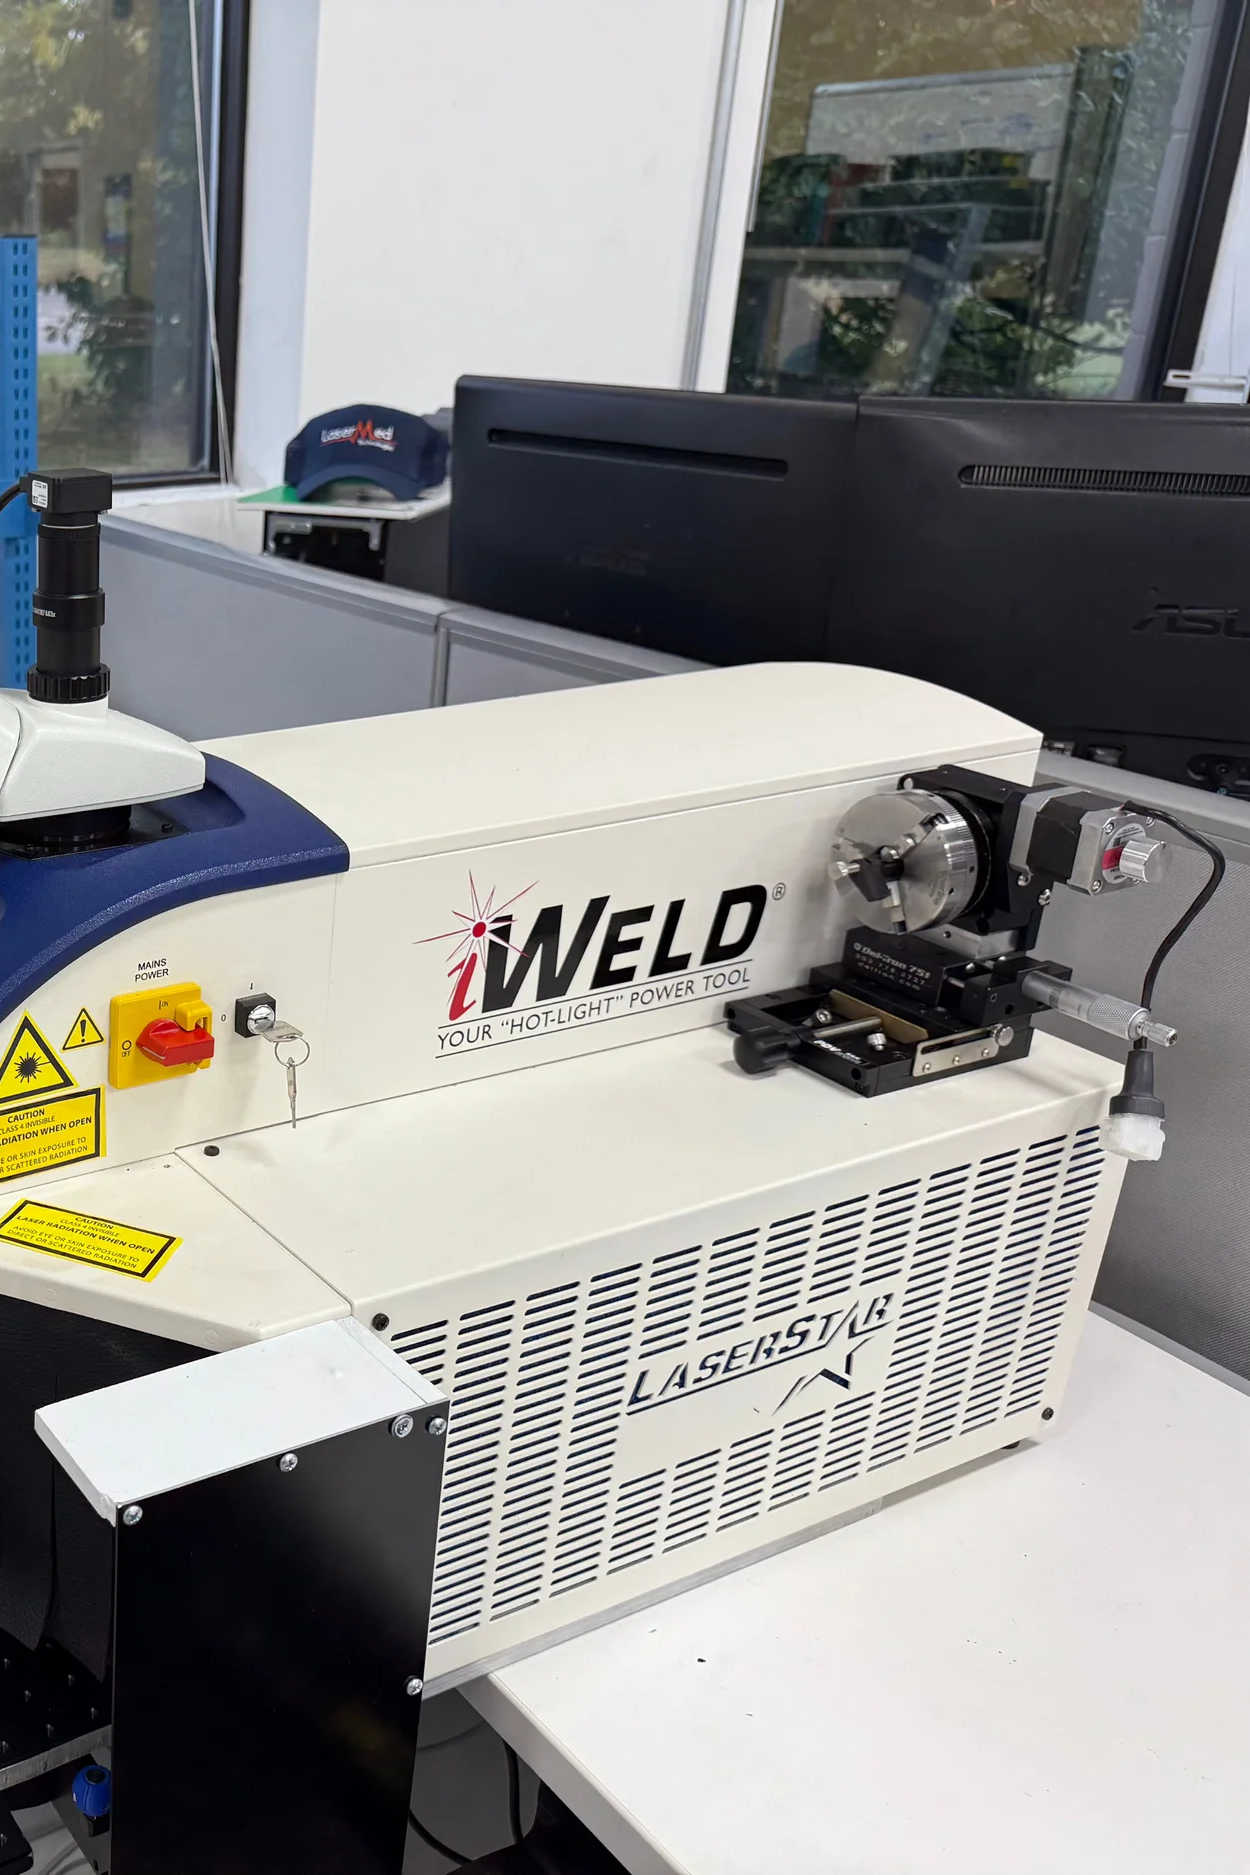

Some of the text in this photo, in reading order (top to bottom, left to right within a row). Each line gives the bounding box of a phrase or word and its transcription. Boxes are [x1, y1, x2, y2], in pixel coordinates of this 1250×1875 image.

[321, 419, 394, 443] LaserMed
[135, 969, 169, 982] POWER
[138, 958, 166, 971] MAINS
[437, 1024, 493, 1050] YOUR
[629, 979, 695, 1008] POWER
[702, 967, 751, 992] TOOL
[8, 1109, 45, 1123] CAUTION
[25, 1116, 55, 1128] INVISIBLE
[40, 1123, 66, 1136] WHEN
[69, 1116, 92, 1128] OPEN
[6, 1157, 47, 1172] SCATTERED
[50, 1145, 88, 1160] RADIATION
[7, 1154, 18, 1162] OR
[20, 1150, 36, 1159] SKIN
[38, 1139, 75, 1154] EXPOSURE
[16, 1215, 156, 1254] LASER RADIATION WHEN OPEN
[60, 1219, 81, 1227] CLASS
[87, 1225, 121, 1237] INVISIBLE
[75, 1217, 115, 1229] CAUTION
[7, 1229, 34, 1240] DIRECT
[48, 1240, 93, 1256] SCATTERED
[93, 1253, 137, 1268] RADIATION
[13, 1226, 38, 1235] AVOID
[67, 1238, 86, 1247] SKIN
[86, 1244, 127, 1259] EXPOSURE
[128, 1255, 140, 1263] TO
[627, 1293, 894, 1406] LASERSTAR
